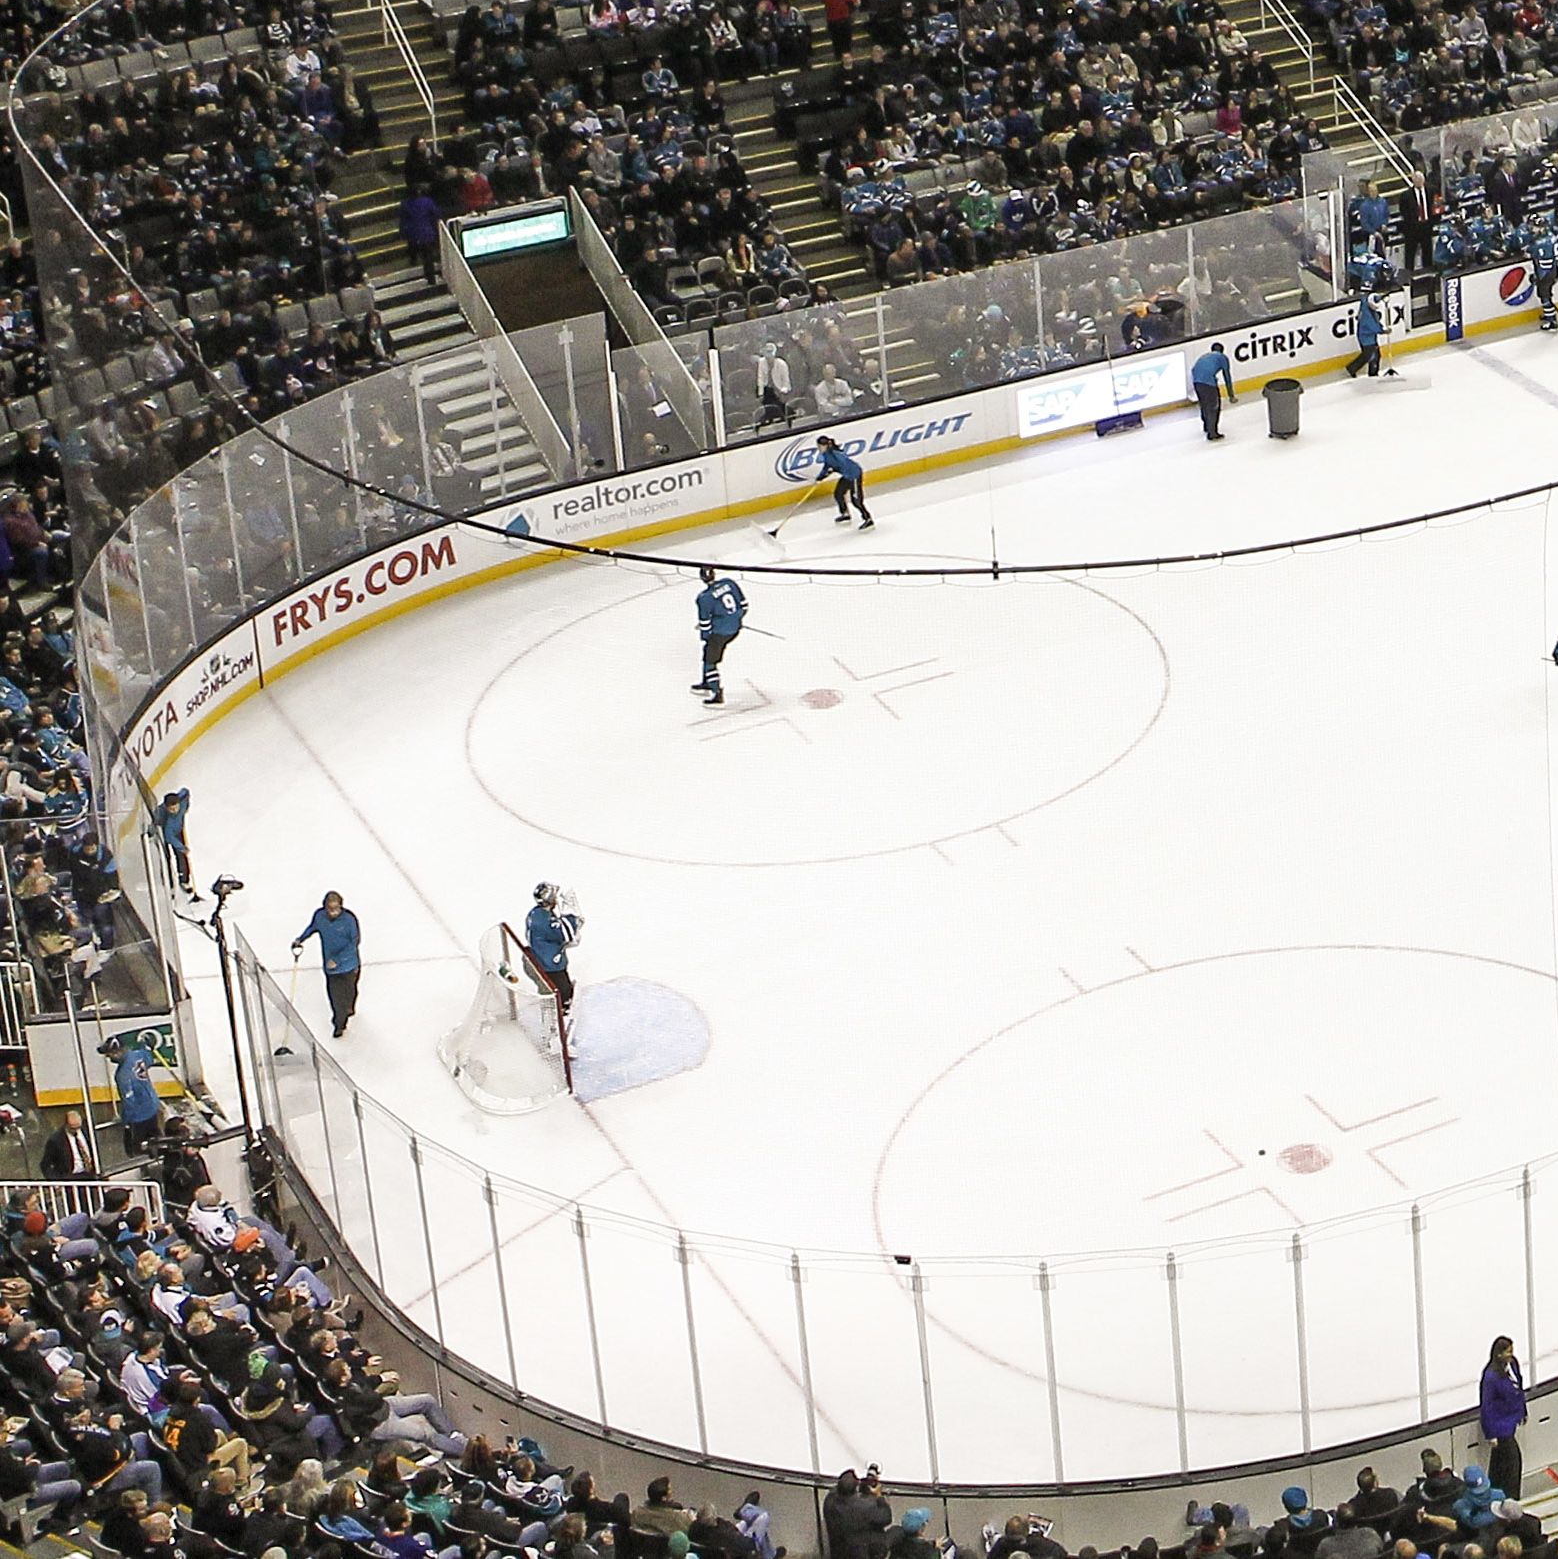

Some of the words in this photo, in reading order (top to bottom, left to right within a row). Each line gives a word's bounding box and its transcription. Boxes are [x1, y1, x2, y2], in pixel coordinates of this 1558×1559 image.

[1447, 279, 1458, 328] Reebok
[790, 439, 866, 472] BD
[868, 412, 973, 453] LIGHT
[553, 469, 703, 520] realtor.com
[555, 521, 592, 536] where
[593, 509, 627, 526] home
[629, 498, 680, 517] happens
[272, 535, 457, 647] FRYS.COM
[721, 593, 737, 615] 9
